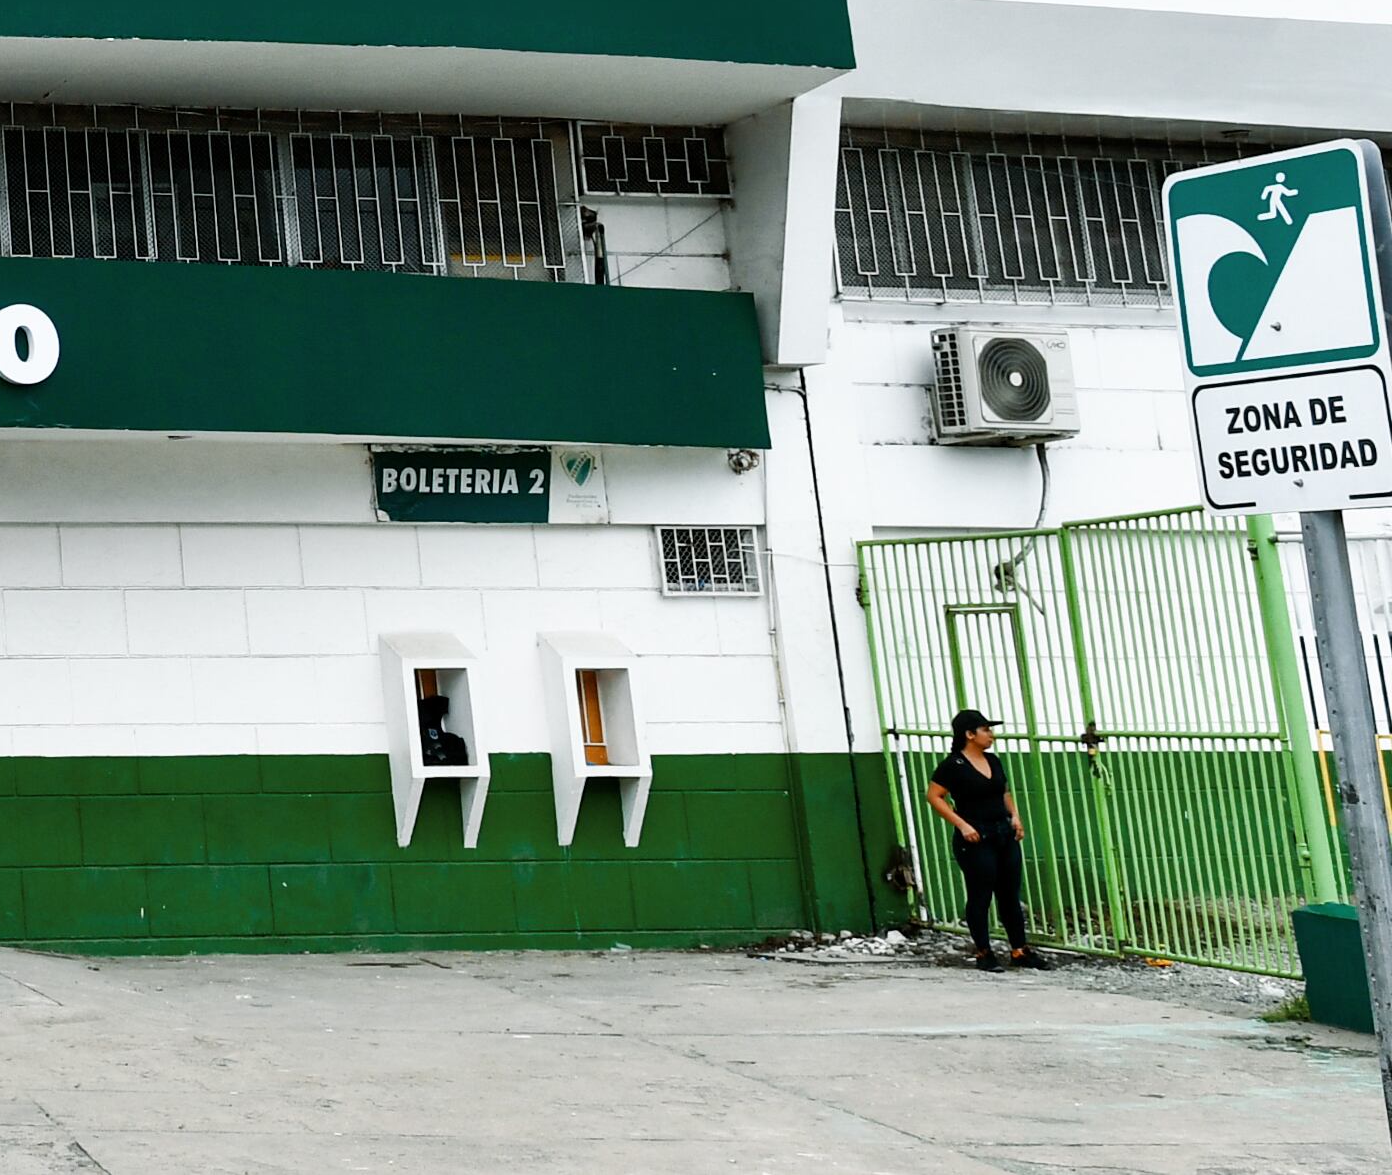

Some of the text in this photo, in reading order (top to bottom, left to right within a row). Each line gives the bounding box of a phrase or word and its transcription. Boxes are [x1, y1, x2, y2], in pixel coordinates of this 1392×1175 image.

[1225, 395, 1347, 435] ZONA DE
[1217, 438, 1379, 480] SEGURIDAD
[381, 467, 545, 495] BOLETERIA 2
